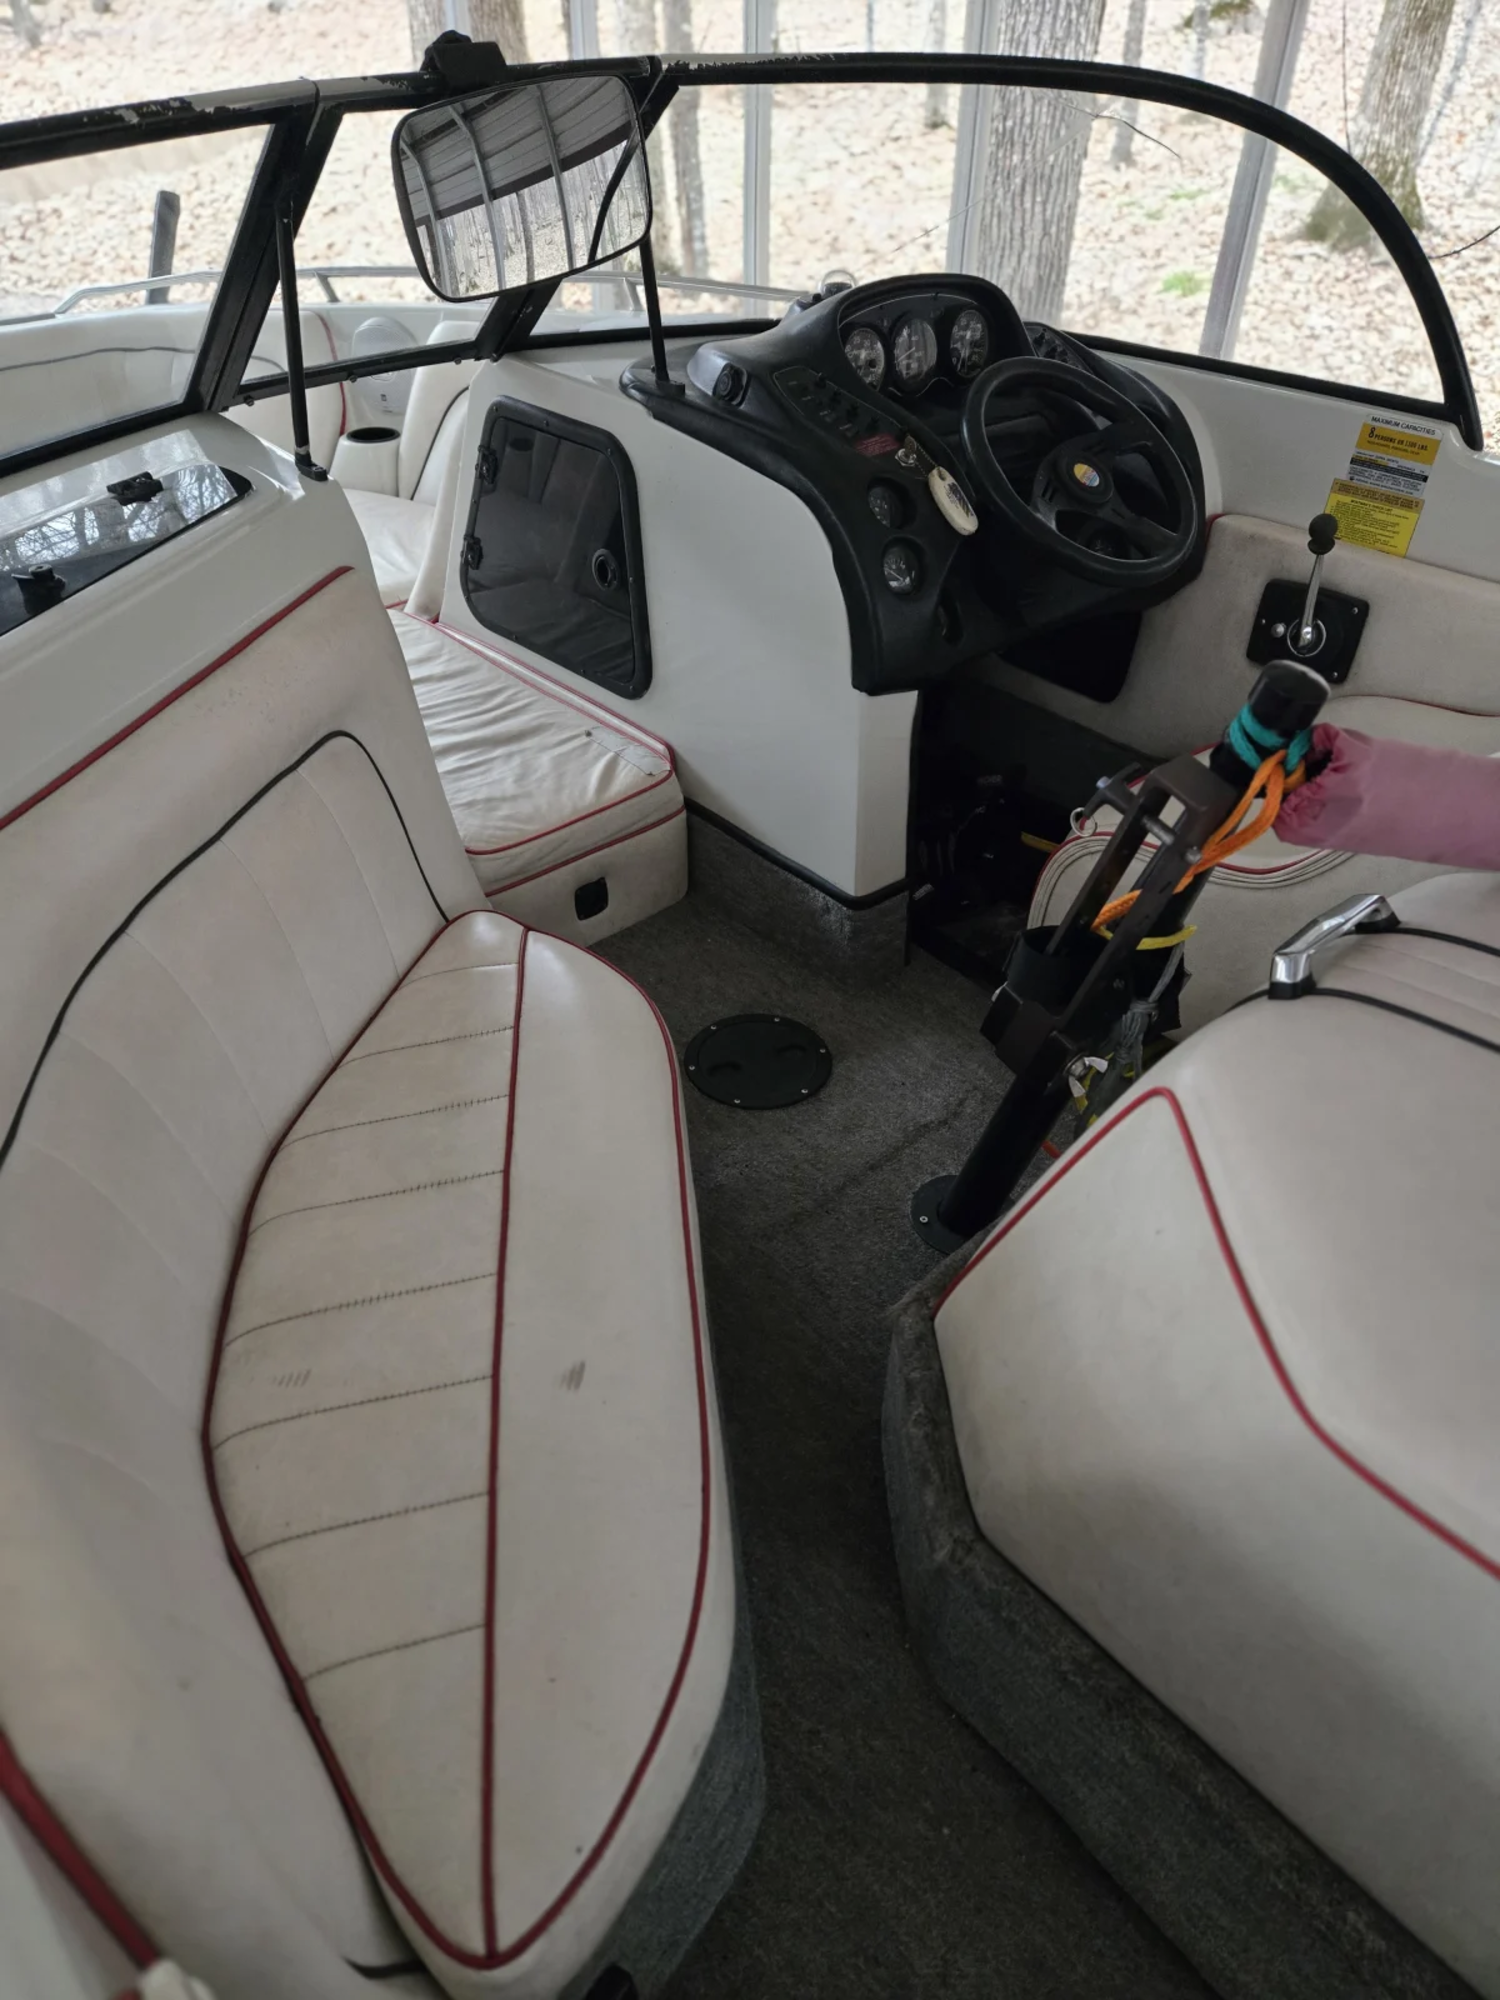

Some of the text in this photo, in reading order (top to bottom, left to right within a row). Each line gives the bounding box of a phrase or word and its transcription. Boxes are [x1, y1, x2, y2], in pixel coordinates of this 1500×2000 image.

[1368, 426, 1376, 438] 8
[1371, 416, 1435, 435] MAXIMUM CAPACITIES
